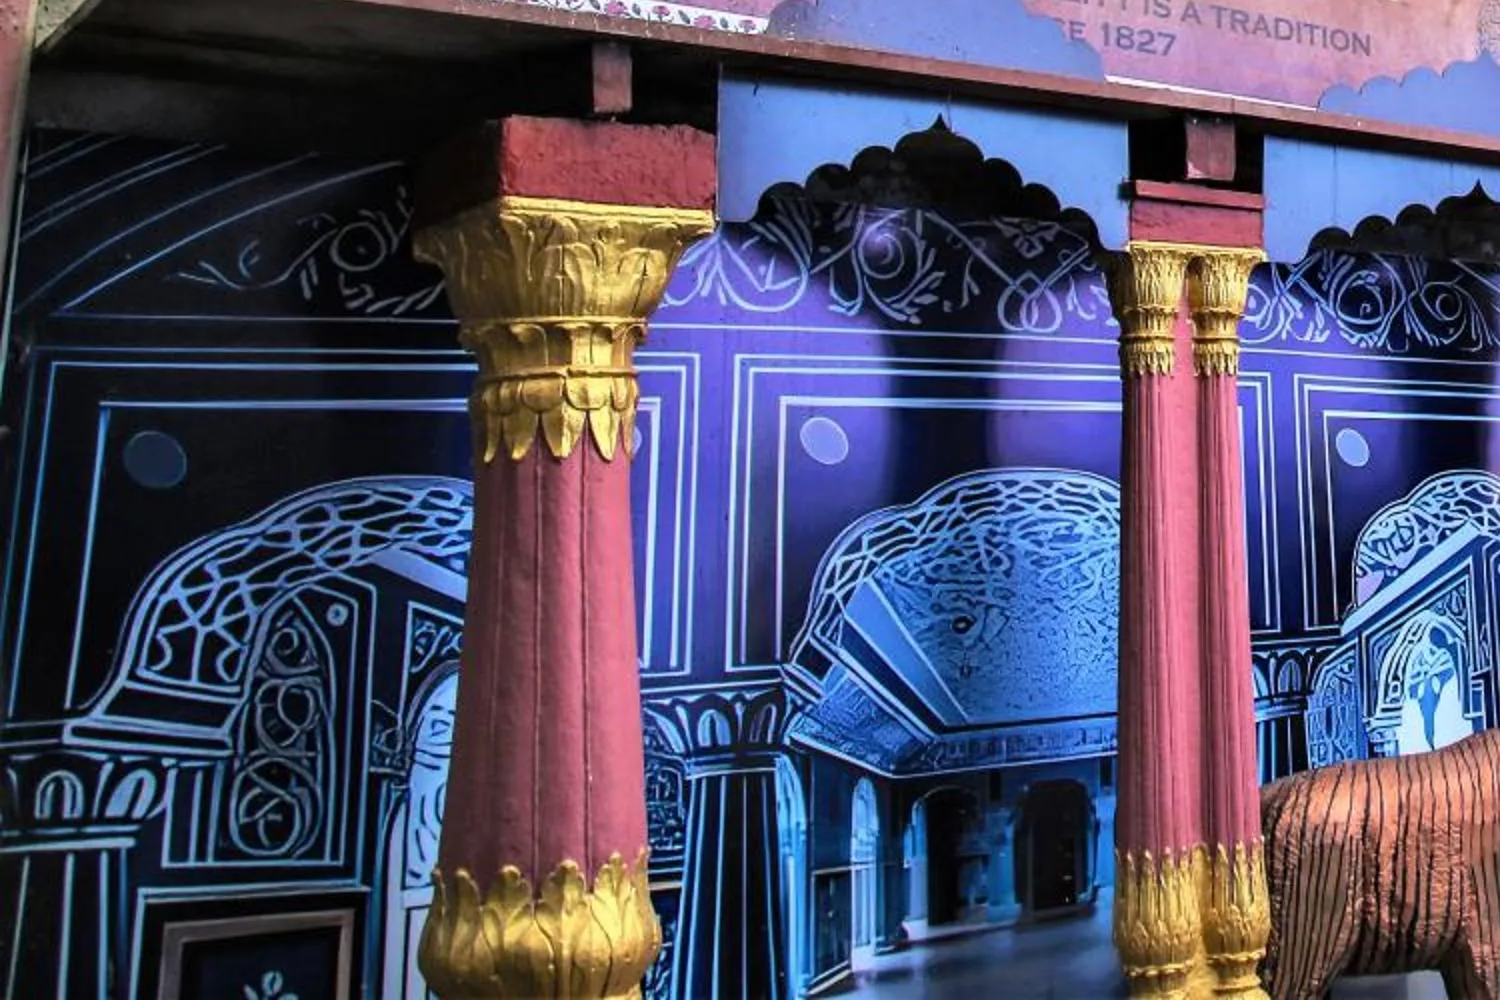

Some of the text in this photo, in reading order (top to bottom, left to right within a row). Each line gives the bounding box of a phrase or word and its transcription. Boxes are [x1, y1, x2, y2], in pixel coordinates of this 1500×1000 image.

[1101, 21, 1177, 57] 1827
[1180, 0, 1203, 25] A
[1210, 5, 1371, 56] TRADITION
